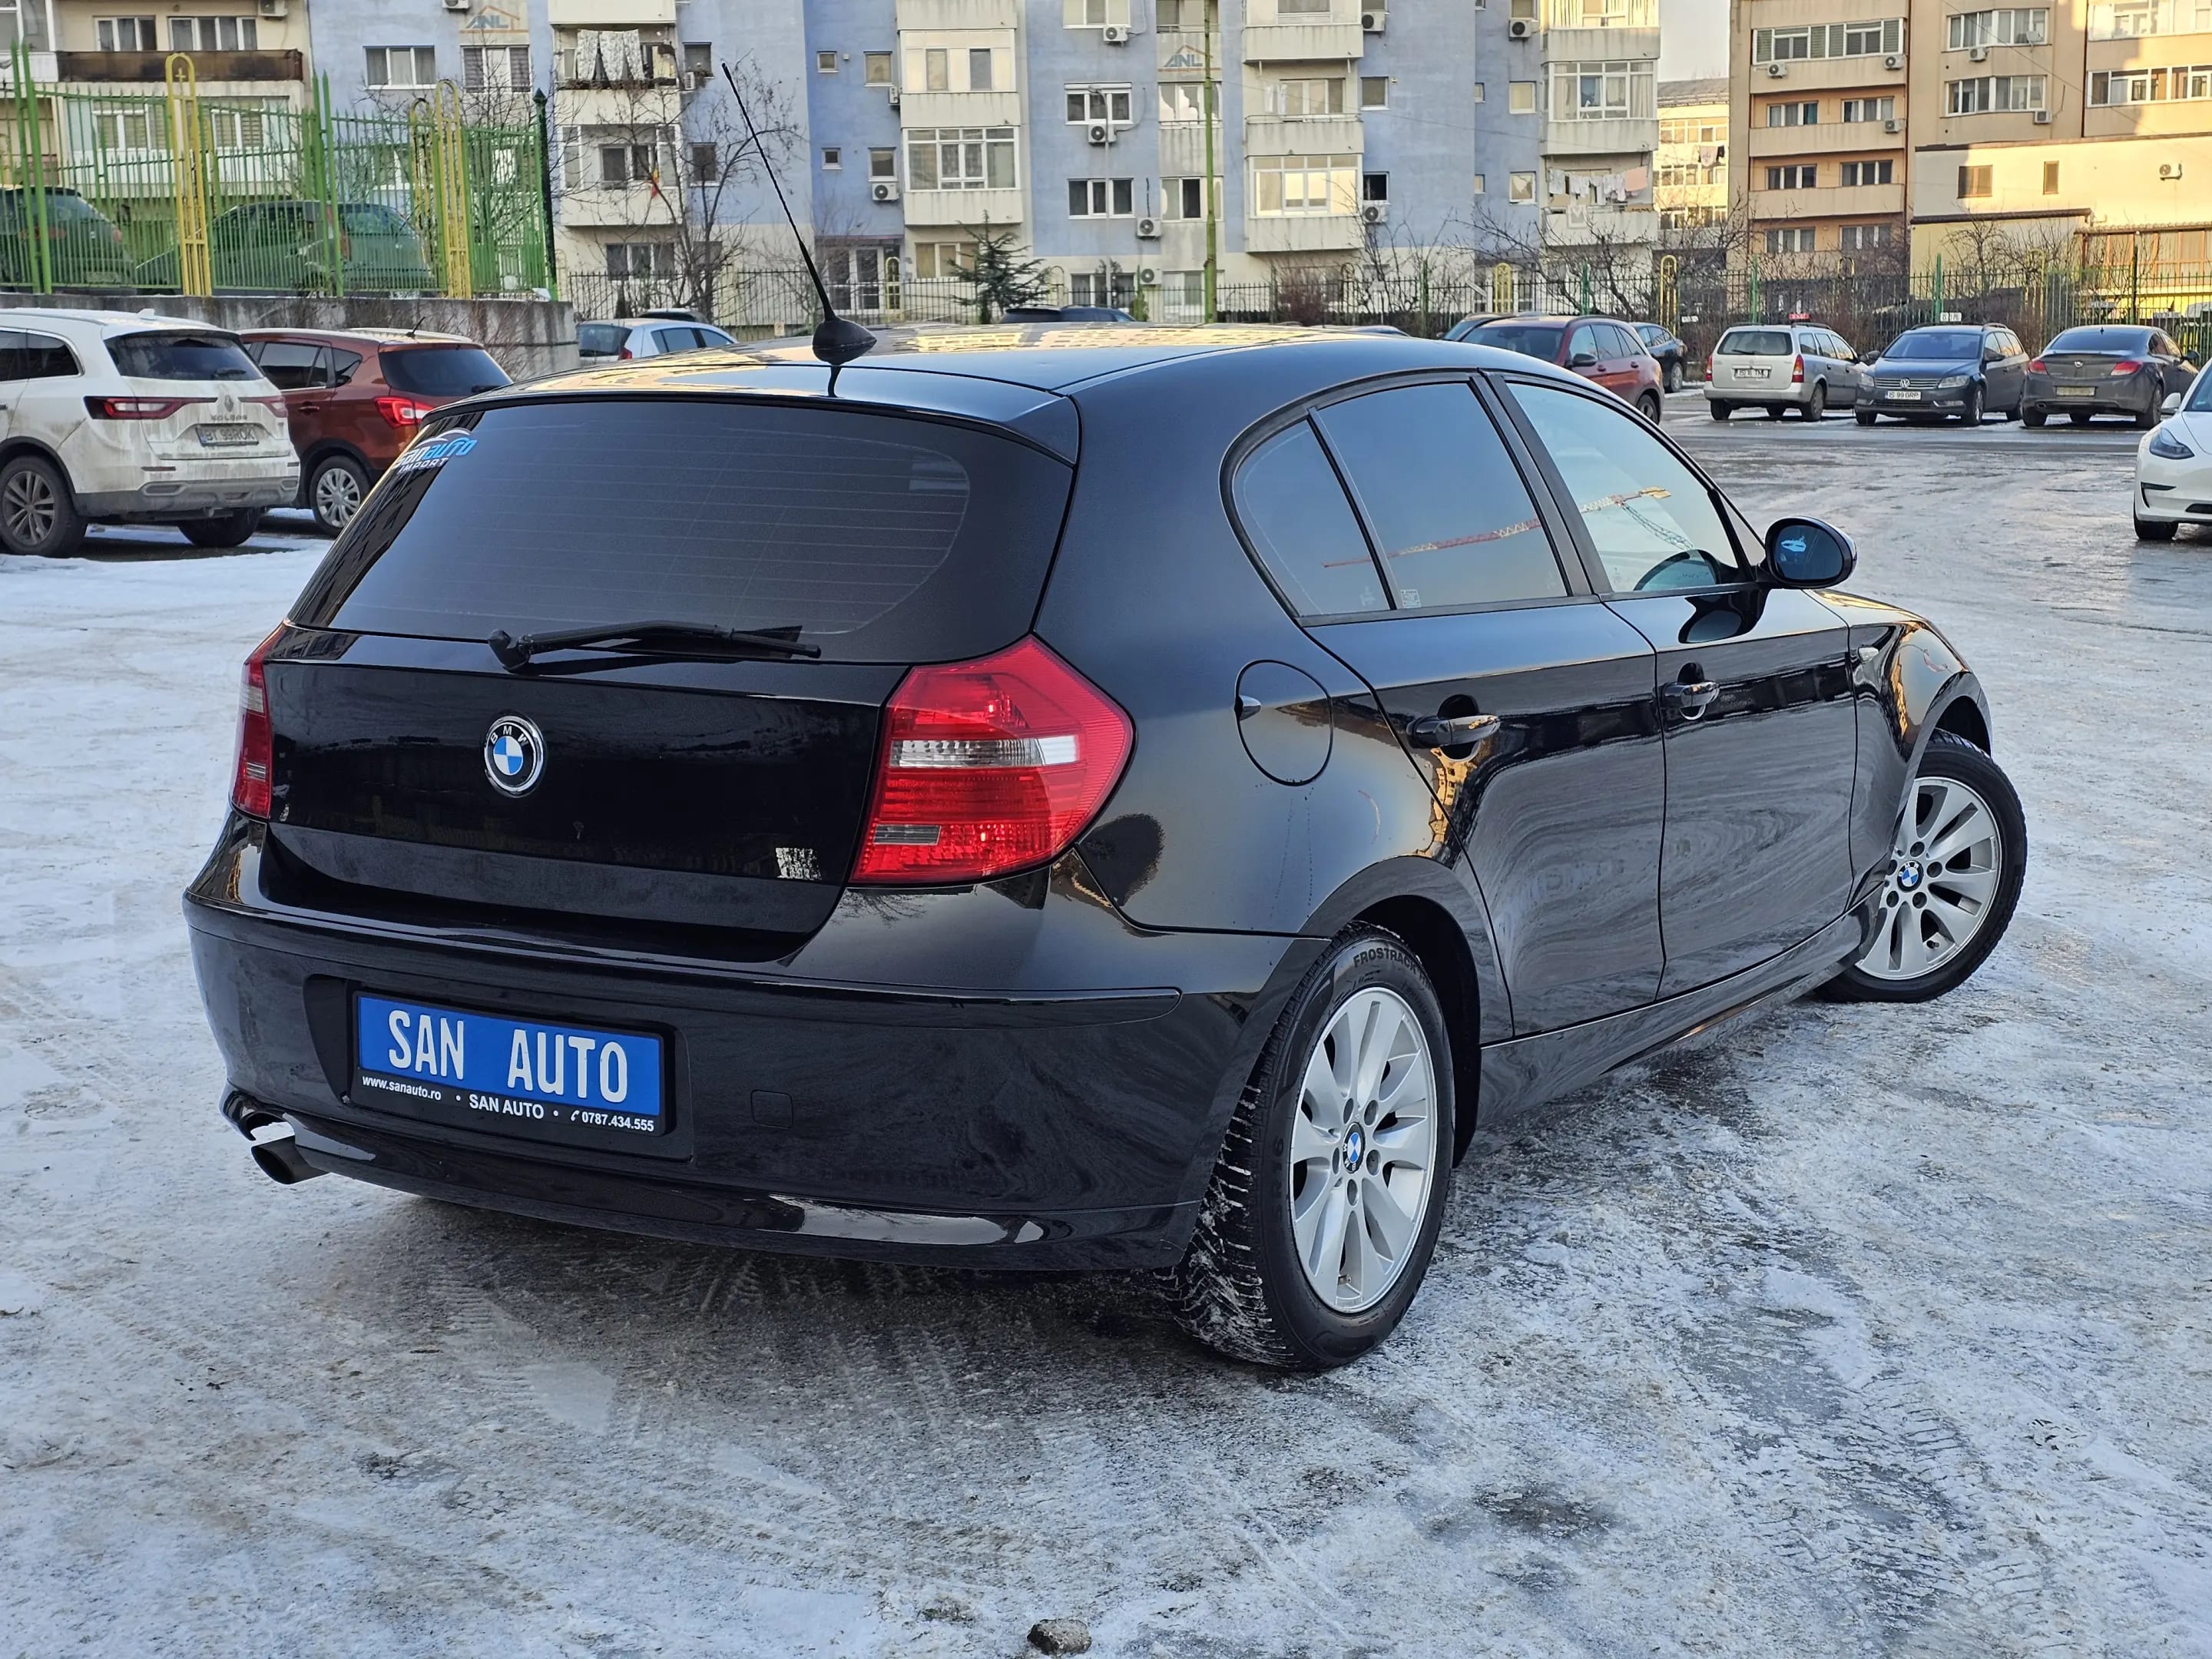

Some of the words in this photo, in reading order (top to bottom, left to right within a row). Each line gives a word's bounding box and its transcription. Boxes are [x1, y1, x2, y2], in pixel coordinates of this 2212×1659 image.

[466, 15, 508, 28] ANL
[1164, 54, 1204, 67] ANL
[397, 457, 449, 475] IMPORT
[490, 725, 529, 747] BMW
[1353, 947, 1417, 975] FROSTRACK
[388, 1009, 464, 1080] SAN
[507, 1028, 628, 1104] AUTO
[362, 1075, 442, 1101] www.sanauto.ro
[469, 1094, 499, 1113] SAN
[502, 1099, 545, 1119] AUTO
[581, 1111, 654, 1132] 0787.434.555
